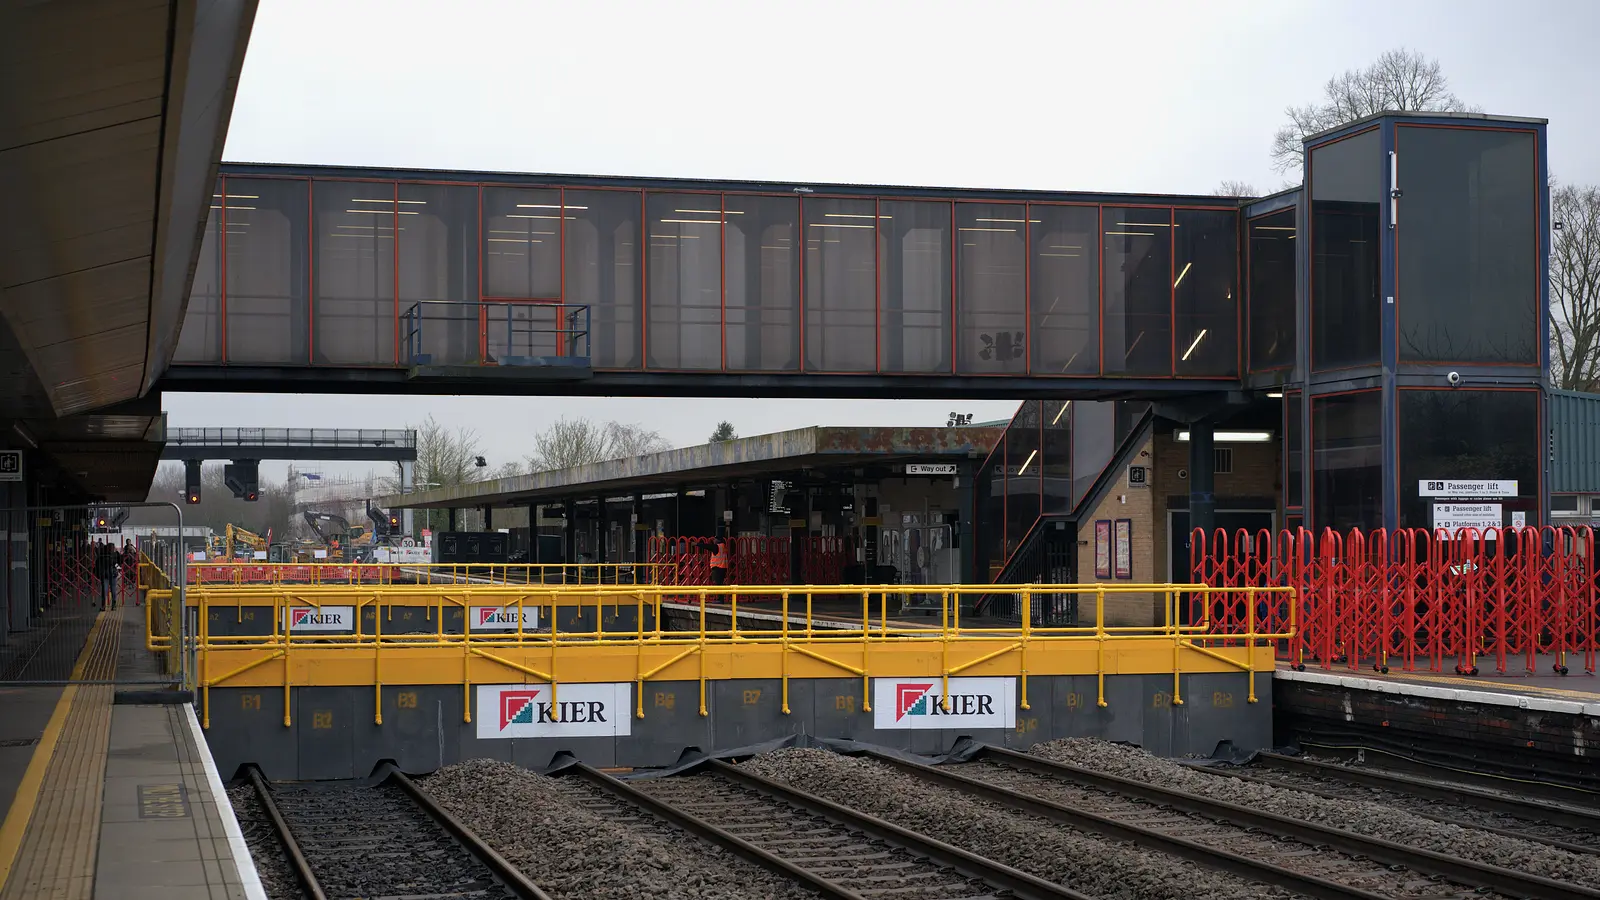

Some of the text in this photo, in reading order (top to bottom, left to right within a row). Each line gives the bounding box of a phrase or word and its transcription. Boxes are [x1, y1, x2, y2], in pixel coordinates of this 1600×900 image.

[309, 614, 341, 624] KIER
[496, 612, 527, 623] KIER
[241, 694, 261, 711] B1
[398, 692, 417, 708] B3
[744, 690, 761, 704] B7
[930, 695, 995, 715] KIER
[312, 710, 332, 729] B2
[537, 701, 607, 723] KIER
